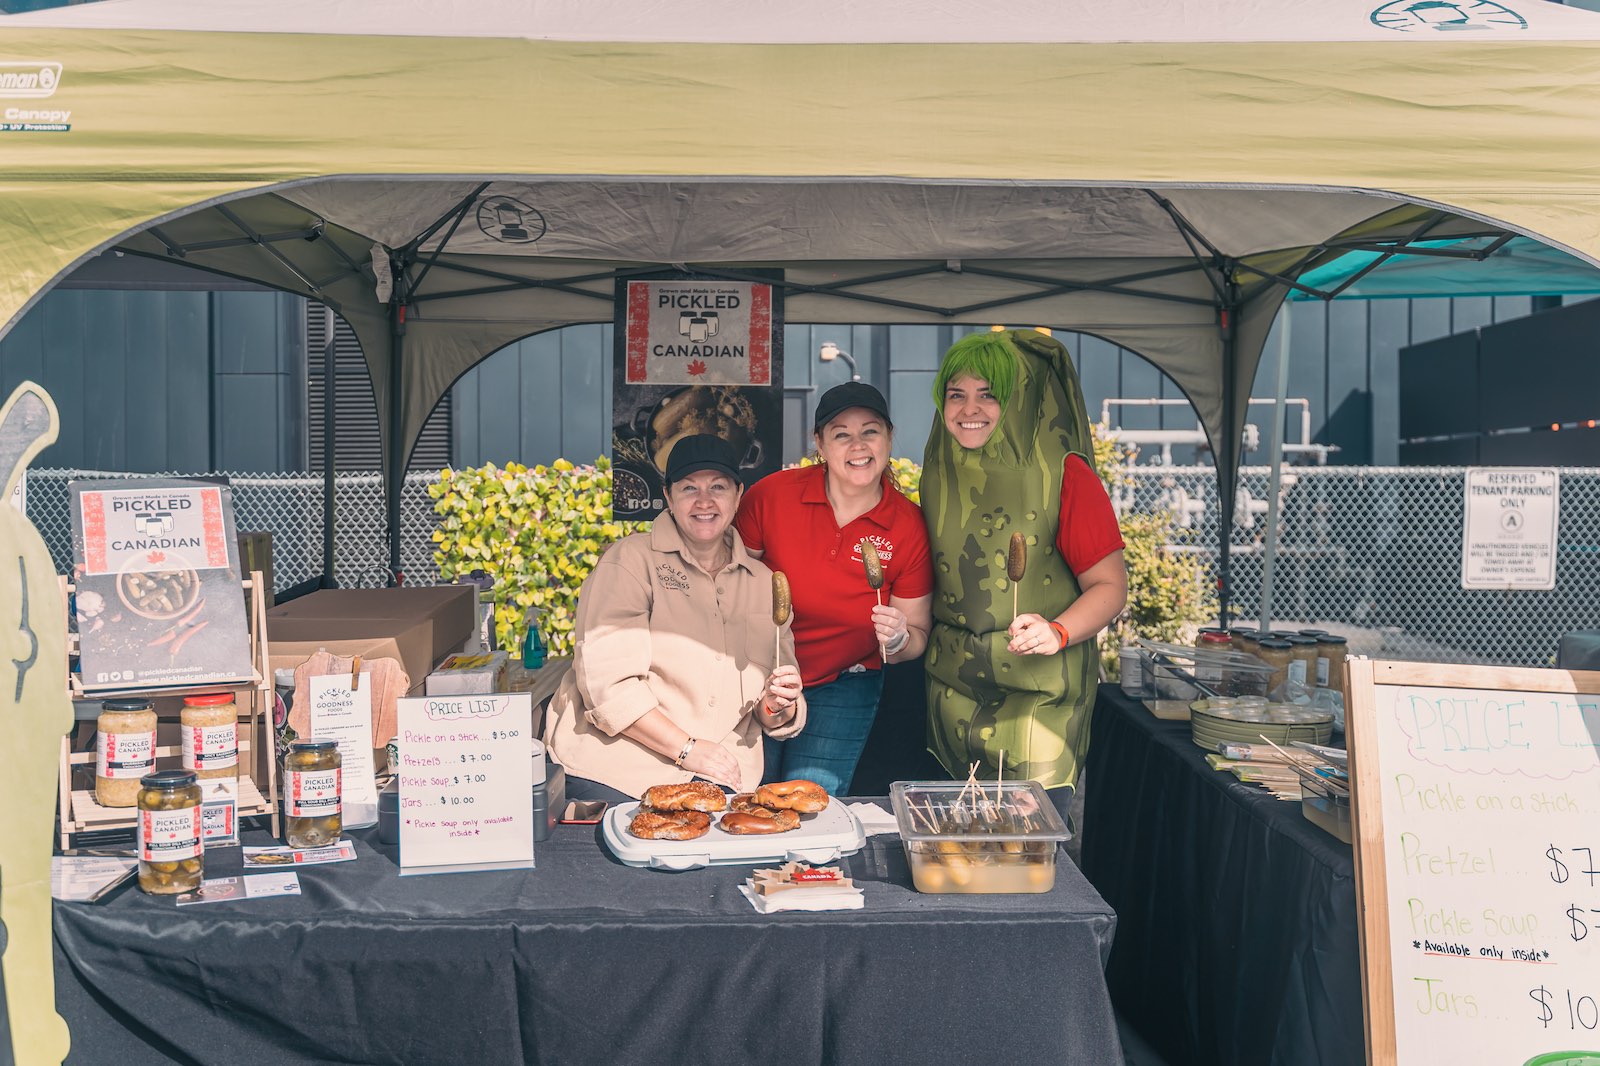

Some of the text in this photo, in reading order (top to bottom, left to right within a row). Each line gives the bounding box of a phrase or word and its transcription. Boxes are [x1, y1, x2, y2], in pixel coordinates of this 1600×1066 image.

[5, 108, 71, 122] Canopy
[659, 295, 740, 309] PICKLED
[653, 344, 744, 357] CANADIAN
[1488, 474, 1536, 484] RESERVED
[1472, 486, 1552, 496] TENANT PARKING
[113, 499, 192, 512] PICKLED
[1500, 498, 1526, 508] ONLY
[111, 537, 201, 551] CANADIAN
[859, 535, 893, 551] PICKLED
[319, 688, 351, 700] PICKLED
[316, 700, 354, 709] GOODNESS
[430, 700, 498, 715] PRICE LIST
[1408, 695, 1530, 752] PRICE
[205, 737, 235, 745] CANADIAN
[207, 731, 234, 740] PICKLED
[404, 730, 431, 743] Pickle
[120, 740, 149, 748] PICKLED
[401, 776, 427, 787] Pickle
[1395, 773, 1466, 814] Pickle
[1476, 793, 1504, 810] on
[1511, 795, 1524, 811] a
[401, 797, 422, 808] Jars
[154, 824, 191, 833] CANADIAN
[156, 818, 190, 827] PICKLED
[414, 819, 436, 828] Pickle
[462, 819, 479, 827] only
[484, 816, 513, 824] available
[1401, 832, 1497, 876] Pretzel
[1408, 898, 1473, 936] Pickle
[1480, 945, 1504, 960] only
[1414, 977, 1479, 1019] Jars
